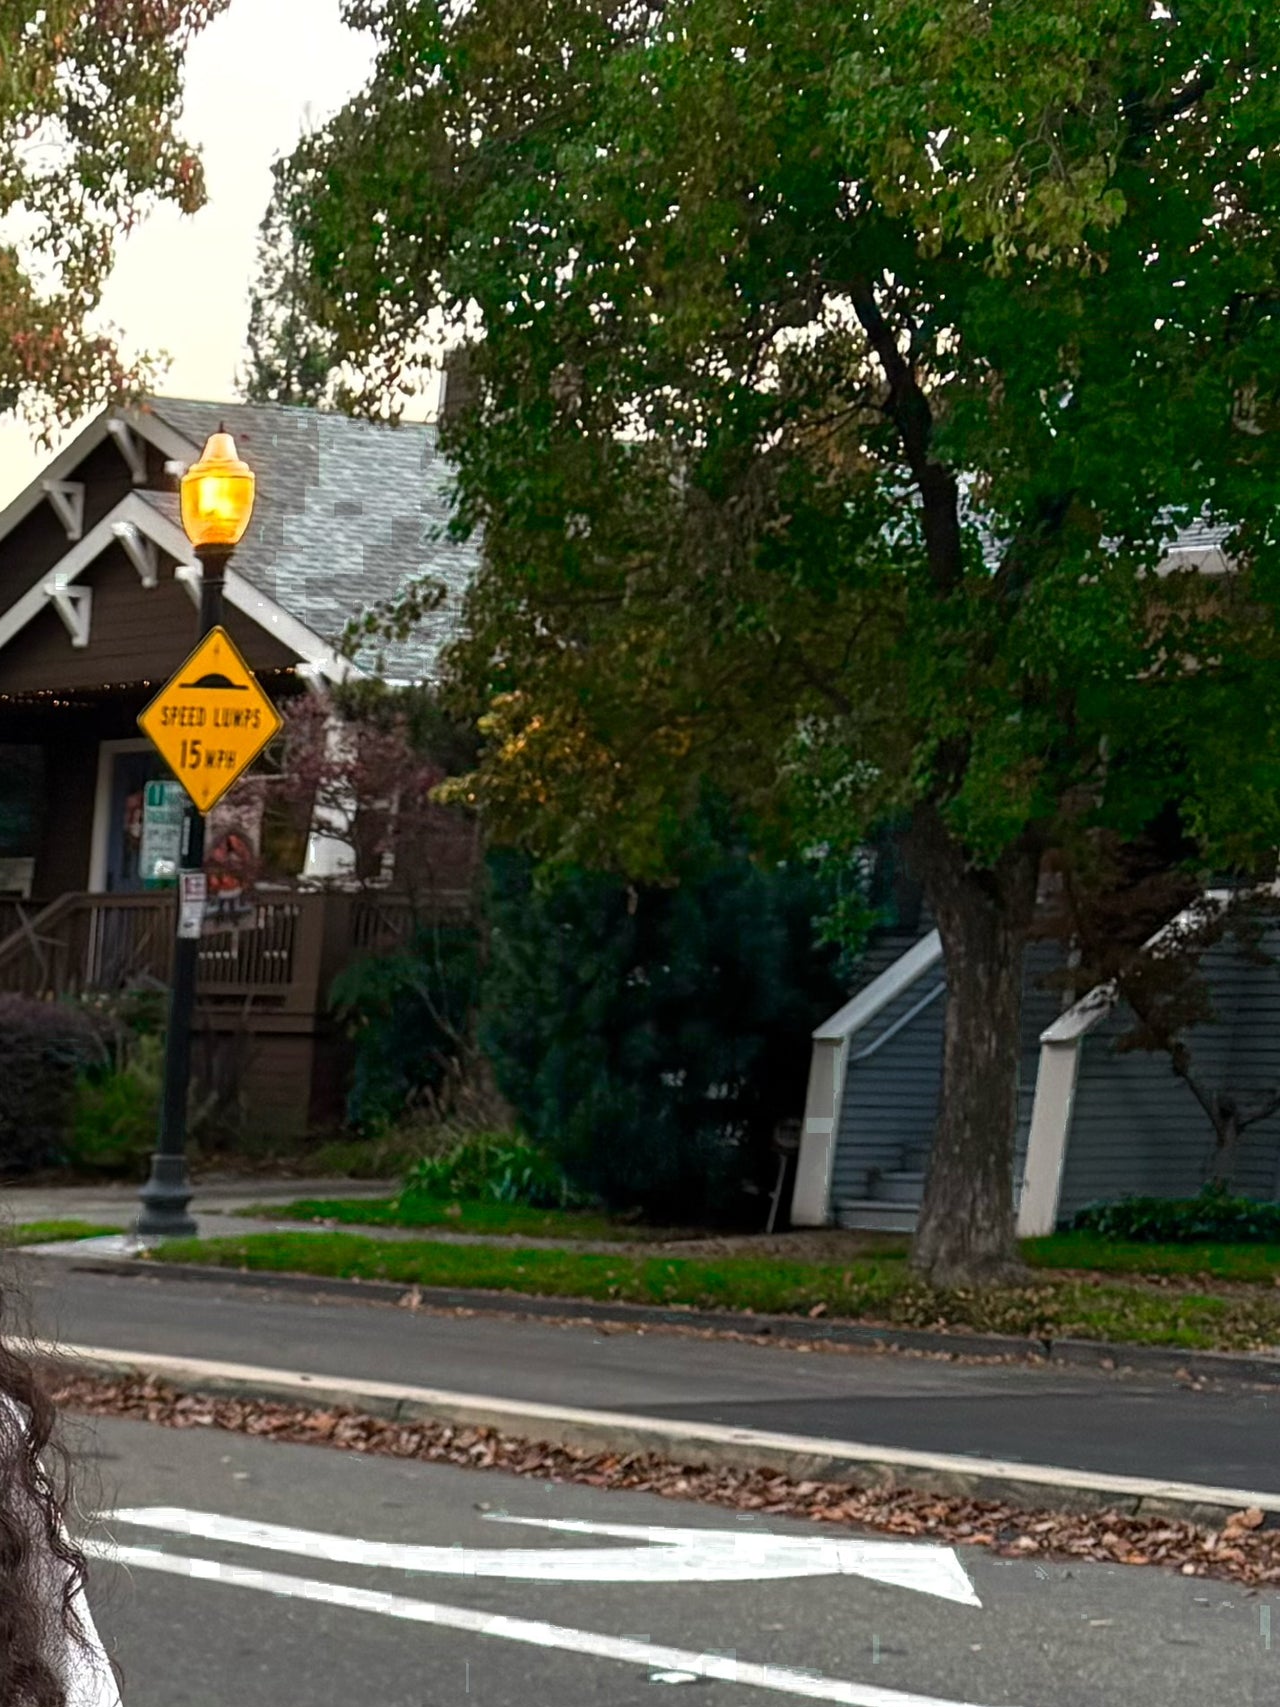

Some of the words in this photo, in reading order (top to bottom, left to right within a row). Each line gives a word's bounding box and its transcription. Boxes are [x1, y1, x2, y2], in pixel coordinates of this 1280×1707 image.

[160, 705, 207, 727] SPEED
[213, 706, 261, 729] LUMPS
[181, 739, 202, 769] 15
[204, 748, 237, 769] MPH
